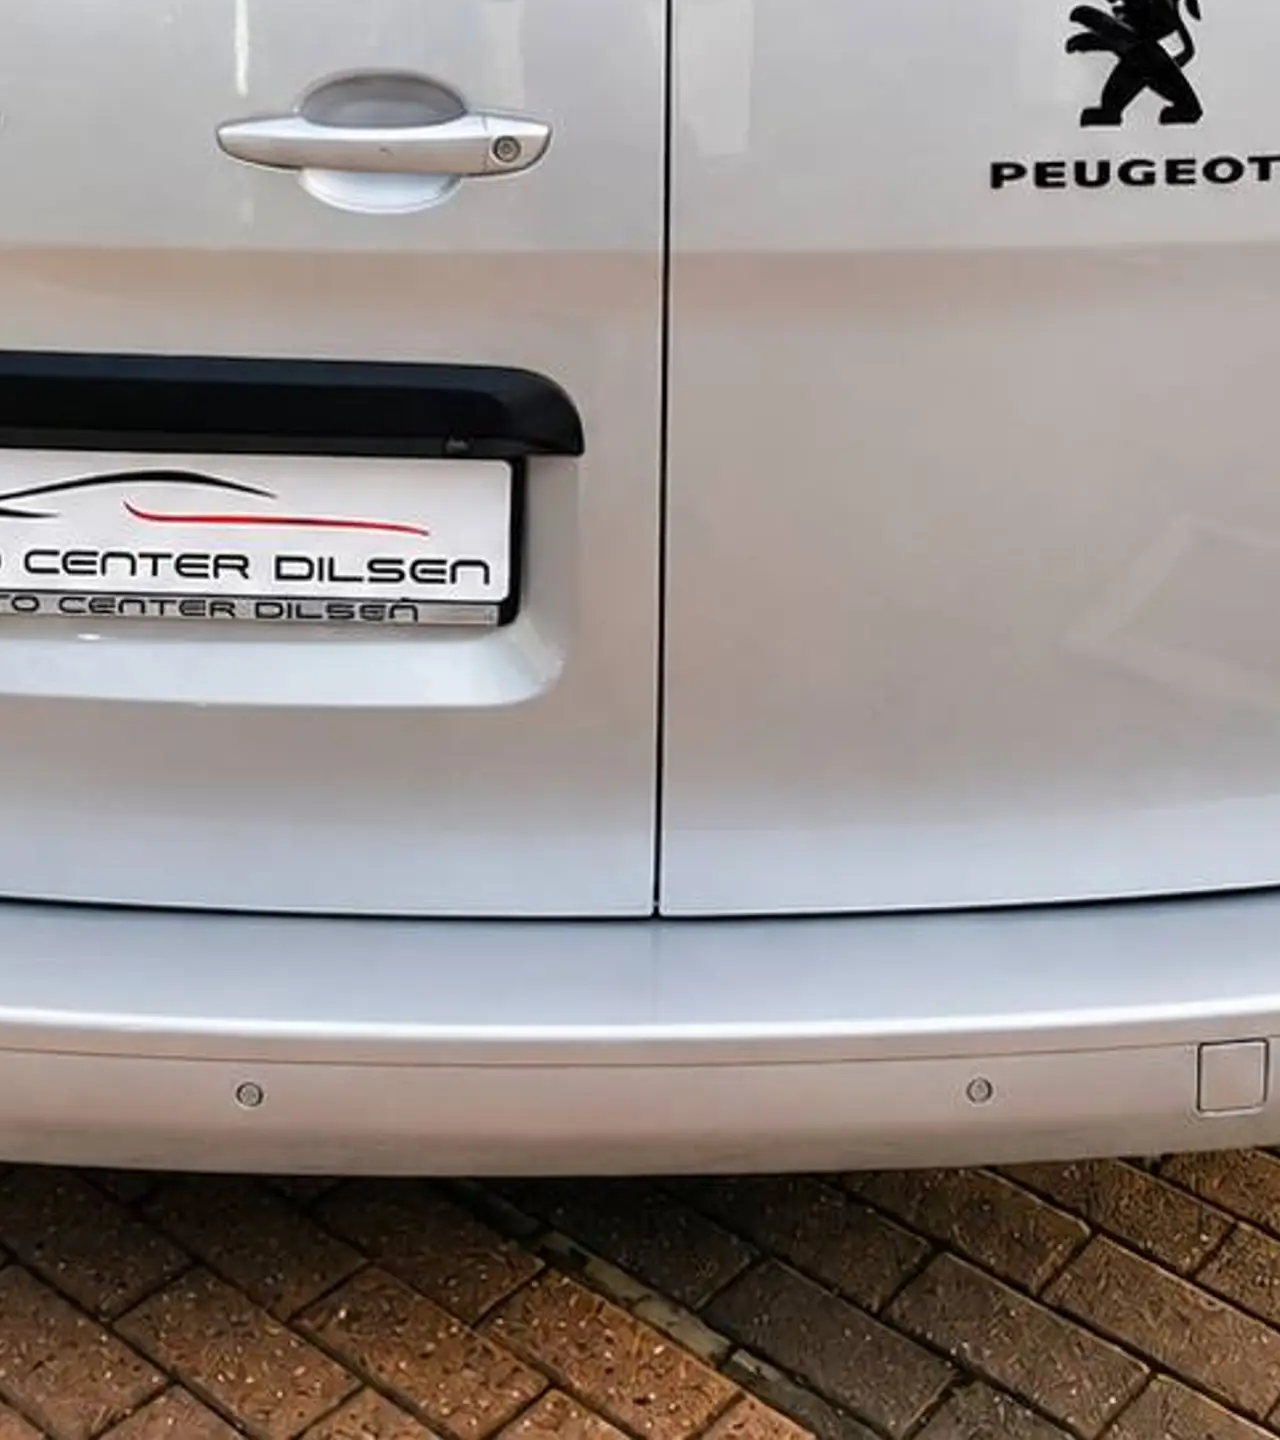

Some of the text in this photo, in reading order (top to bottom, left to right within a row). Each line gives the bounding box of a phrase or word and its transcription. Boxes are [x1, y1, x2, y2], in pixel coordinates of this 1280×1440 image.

[24, 548, 250, 581] CENTER
[275, 555, 491, 586] DILSEN
[58, 596, 236, 619] CENTER
[255, 600, 420, 624] DILSEN
